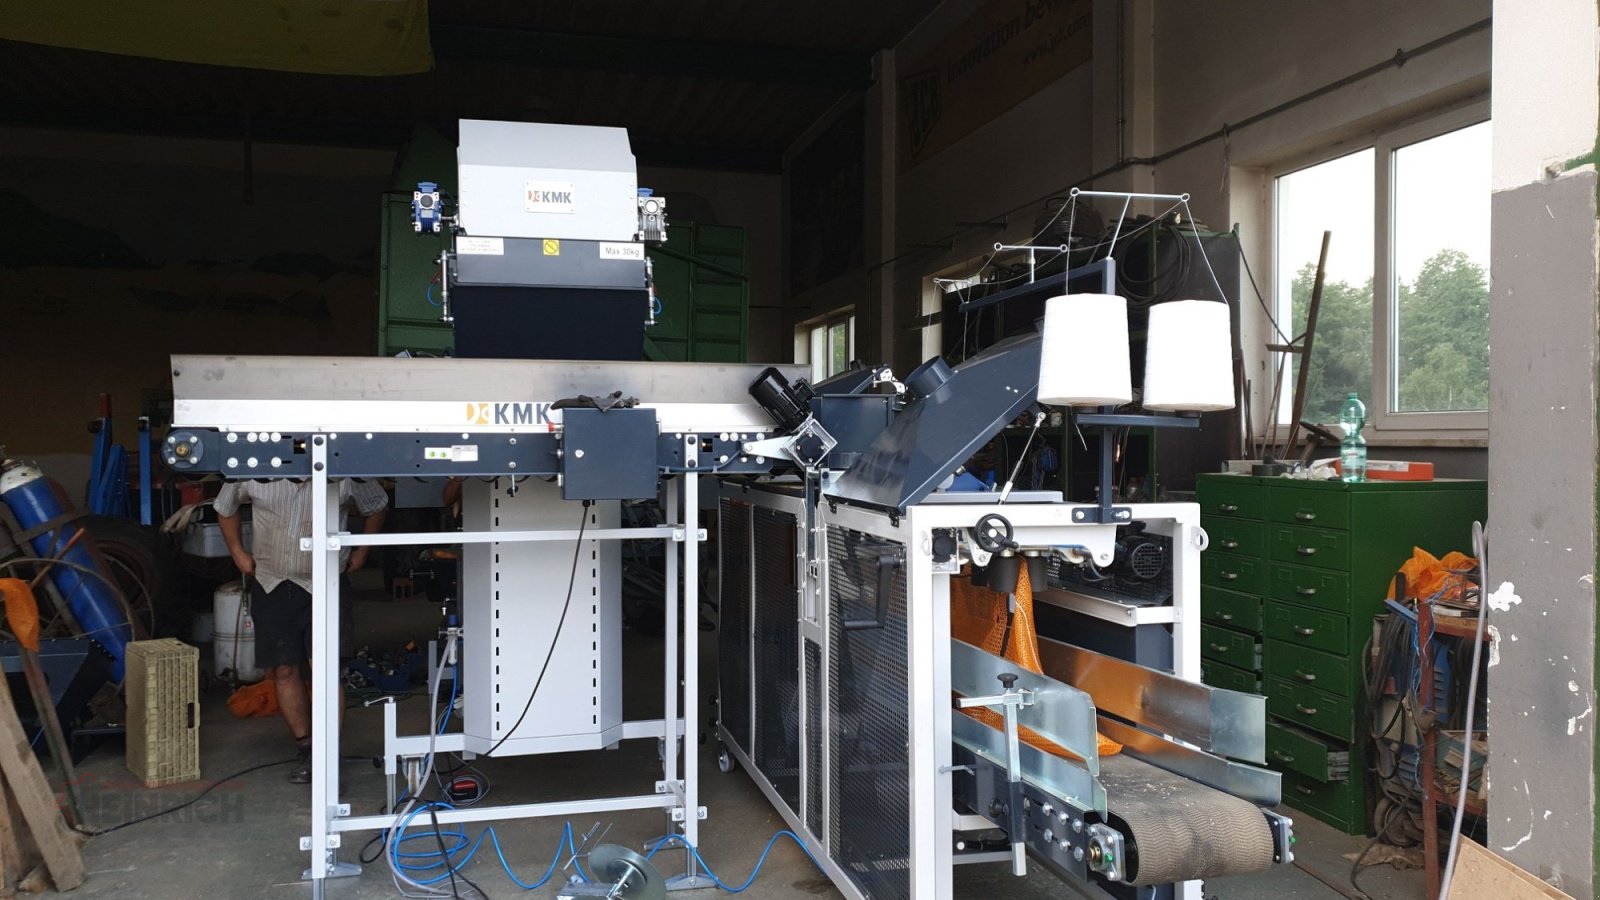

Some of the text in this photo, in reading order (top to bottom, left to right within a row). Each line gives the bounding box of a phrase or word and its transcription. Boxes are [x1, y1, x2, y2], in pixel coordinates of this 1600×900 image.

[542, 191, 572, 204] KMK
[605, 247, 640, 258] Max 30kg
[495, 403, 552, 424] KMK
